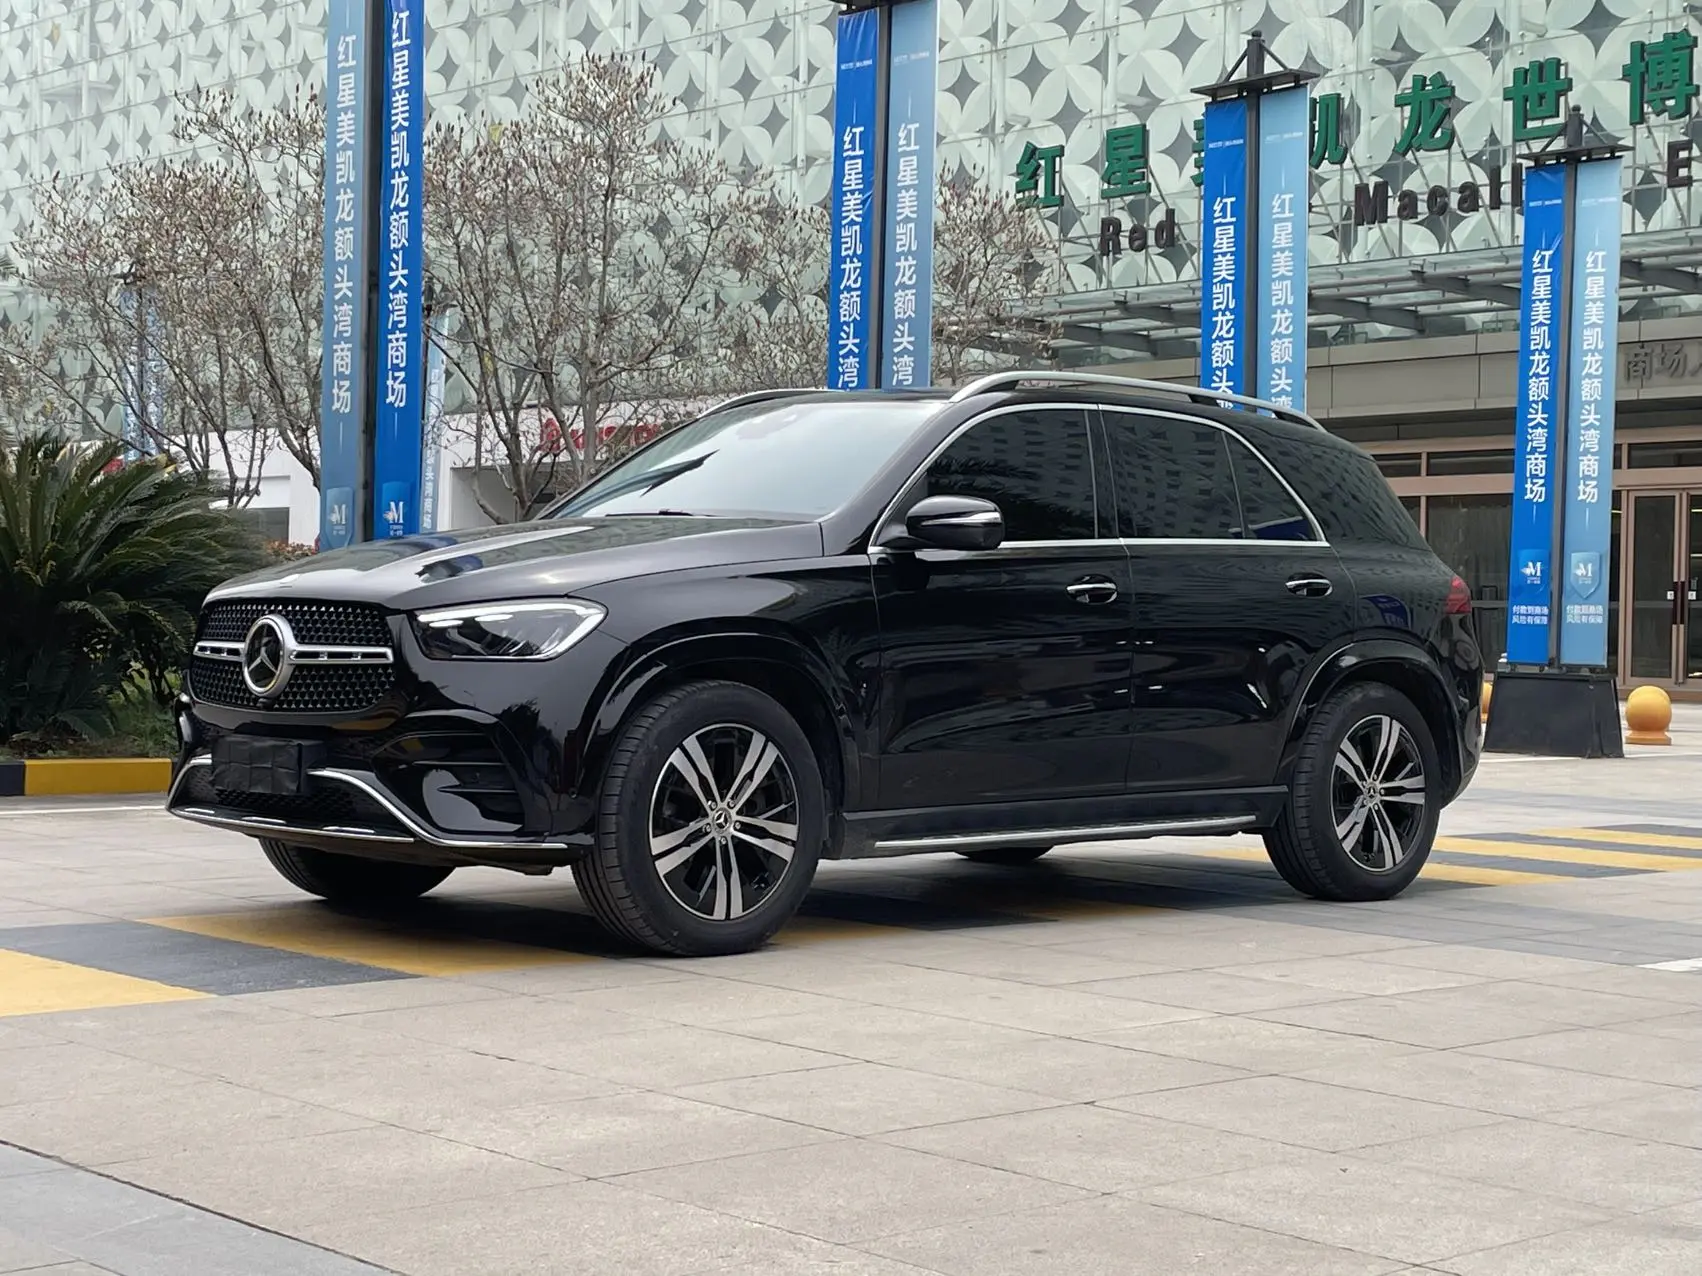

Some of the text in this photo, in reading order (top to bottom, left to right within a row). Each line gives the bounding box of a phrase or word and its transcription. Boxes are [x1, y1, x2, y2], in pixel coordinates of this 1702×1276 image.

[331, 34, 357, 414] 红星美凯龙额头湾商场
[385, 10, 410, 409] 红星美凯龙额头湾商场
[838, 126, 865, 388] 红星美凯龙额头湾
[892, 122, 920, 386] 红星美凯龙额头湾
[1100, 207, 1176, 256] Red
[1524, 249, 1553, 503] 红星美凯龙额头湾商场
[1577, 250, 1607, 503] 红星美凯龙额头湾商场
